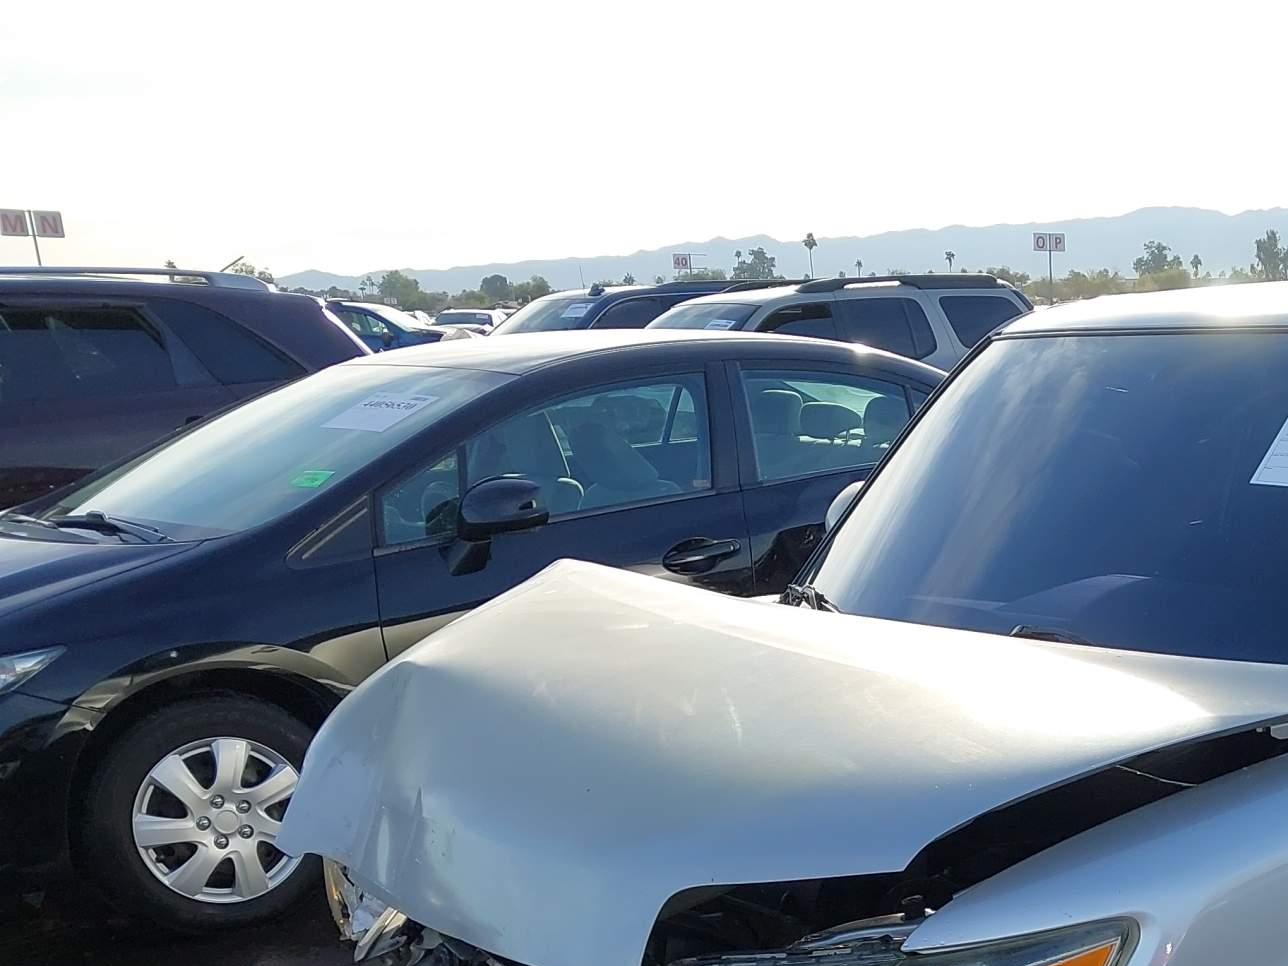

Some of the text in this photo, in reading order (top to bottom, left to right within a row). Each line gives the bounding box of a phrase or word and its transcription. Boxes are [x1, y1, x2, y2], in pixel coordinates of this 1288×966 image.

[0, 214, 60, 234] M N
[1054, 236, 1062, 249] P
[674, 256, 688, 267] 40
